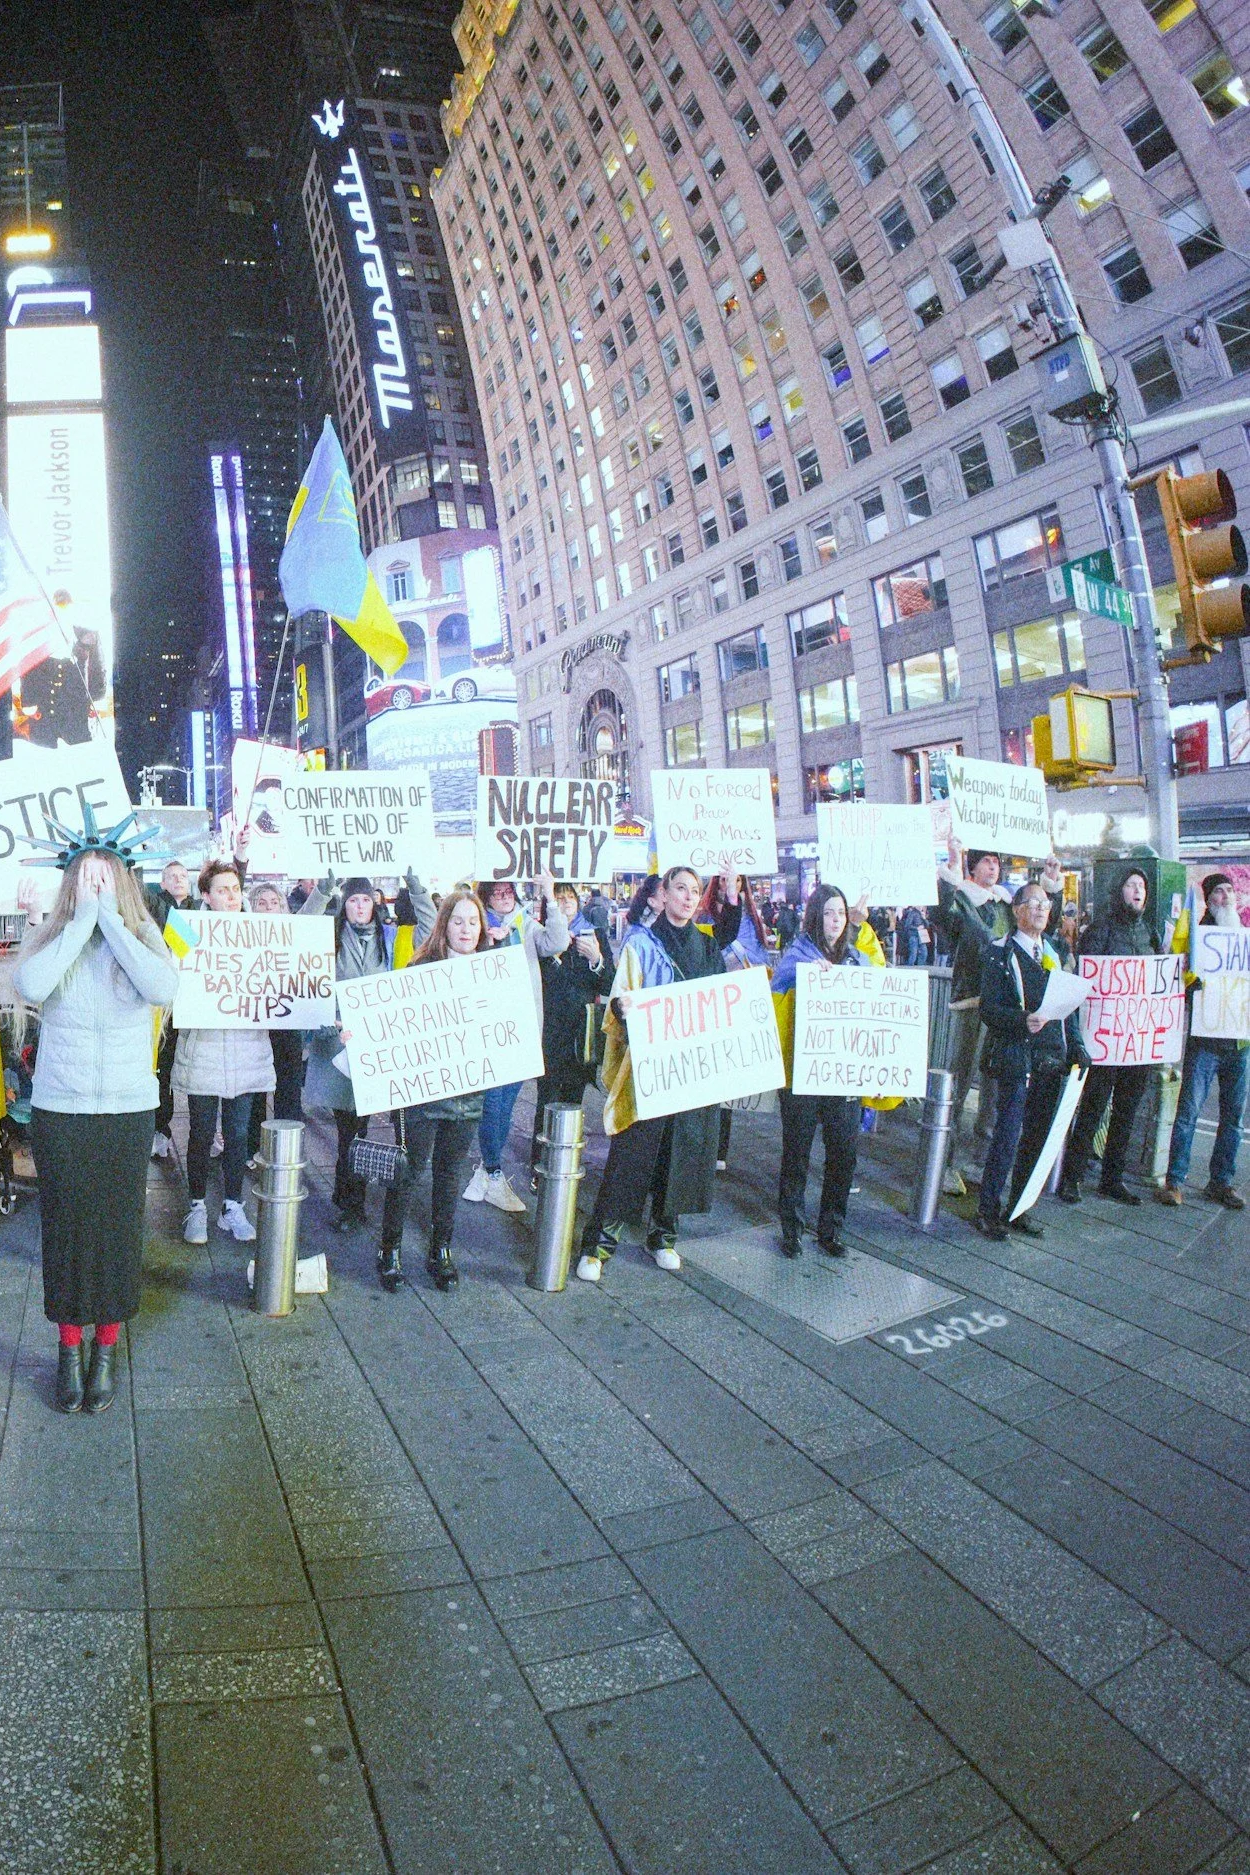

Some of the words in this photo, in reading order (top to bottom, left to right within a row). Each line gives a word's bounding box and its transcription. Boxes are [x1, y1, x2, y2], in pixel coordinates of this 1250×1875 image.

[333, 148, 414, 429] Maserati
[43, 428, 72, 506] Jackson
[210, 455, 224, 487] ROKU
[46, 511, 73, 576] Trevor
[1086, 580, 1099, 611] W
[1105, 587, 1120, 618] 44
[559, 630, 631, 694] Paramount
[230, 690, 244, 730] ROKU
[284, 785, 404, 811] CONFIRMATION
[409, 785, 427, 807] OF
[488, 778, 613, 827] NUCLEAR
[299, 813, 336, 837] THE
[343, 812, 379, 836] END
[385, 812, 410, 835] OF
[822, 806, 883, 838] TRUMP
[312, 841, 351, 864] THE
[357, 840, 396, 863] WAR
[493, 827, 608, 880] SAFETY
[826, 840, 875, 874] Nobel
[860, 876, 901, 900] Prize
[188, 918, 293, 949] UKRAINIAN
[179, 949, 244, 974] LIVES
[249, 950, 290, 974] ARE
[297, 951, 336, 974] NOT
[1151, 957, 1170, 995] IS
[1170, 957, 1180, 994] A
[203, 972, 332, 999] BARGAINING
[345, 964, 455, 1010] SECURITY
[470, 954, 511, 984] FOR
[808, 970, 873, 992] PEACE
[882, 975, 919, 994] MUST
[217, 994, 294, 1023] CHIPS
[637, 984, 743, 1044] TRUMP
[807, 999, 866, 1016] PROTECT
[1085, 993, 1187, 1035] TERRORIST
[359, 1029, 467, 1078] SECURITY
[481, 1020, 521, 1049] FOR
[805, 1025, 835, 1050] NOT
[1091, 1026, 1167, 1064] STATE
[637, 1025, 782, 1098] CHAMBERLAIN
[806, 1059, 913, 1088] AGRESSORS
[388, 1057, 497, 1106] AMERICA
